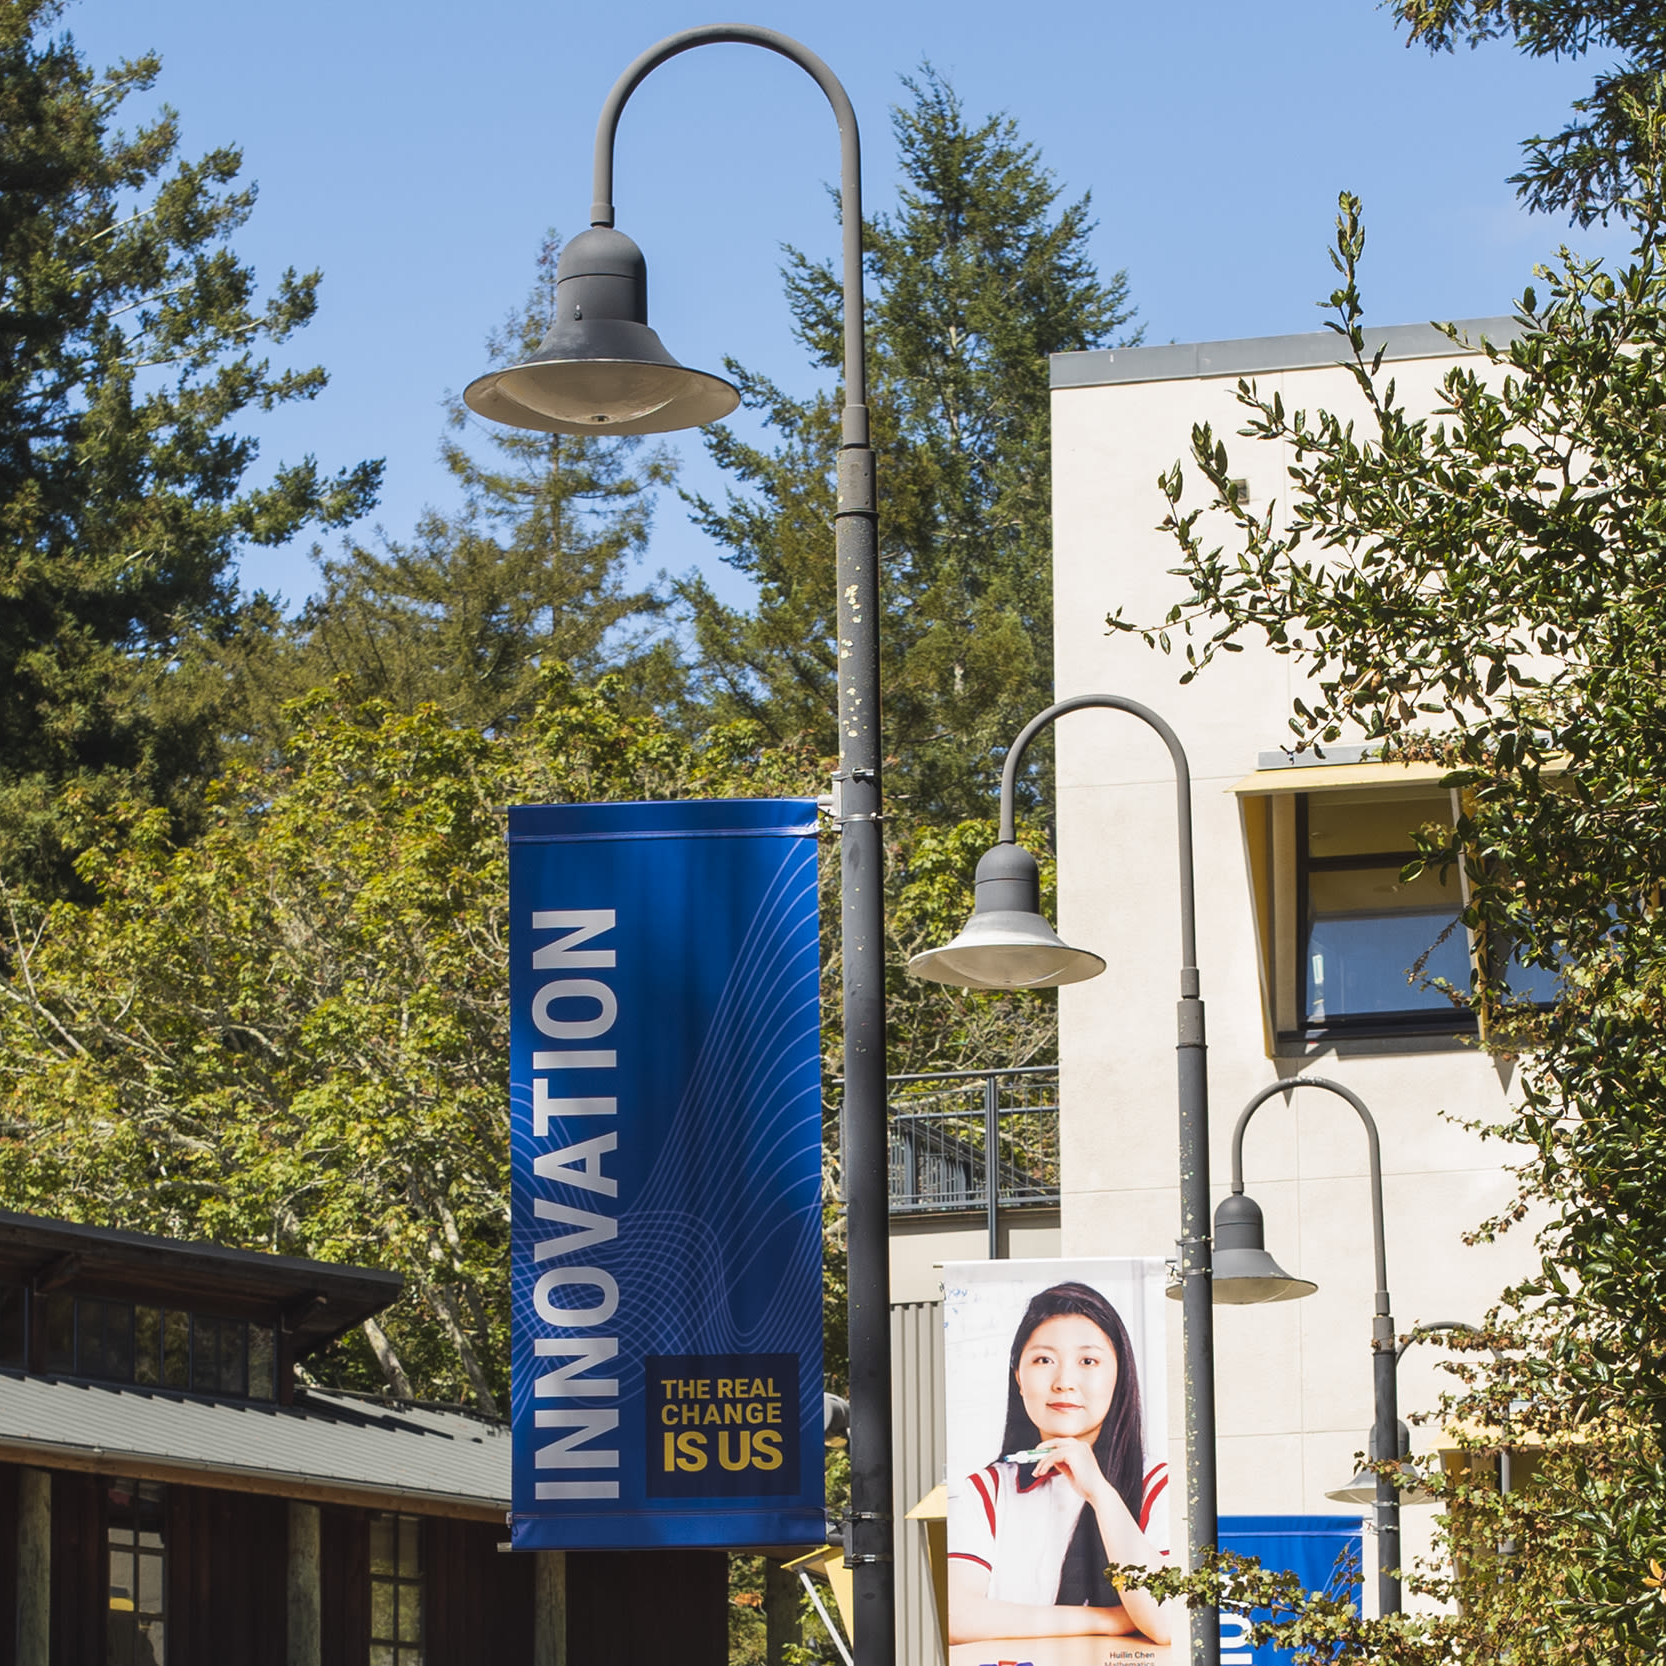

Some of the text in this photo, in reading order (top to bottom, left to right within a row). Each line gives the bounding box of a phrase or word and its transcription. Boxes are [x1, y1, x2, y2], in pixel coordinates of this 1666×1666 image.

[532, 908, 620, 1500] INNOVATION
[661, 1378, 781, 1399] THE REAL
[661, 1403, 782, 1425] CHANGE
[664, 1429, 783, 1472] IS US
[1134, 1650, 1155, 1660] Chen
